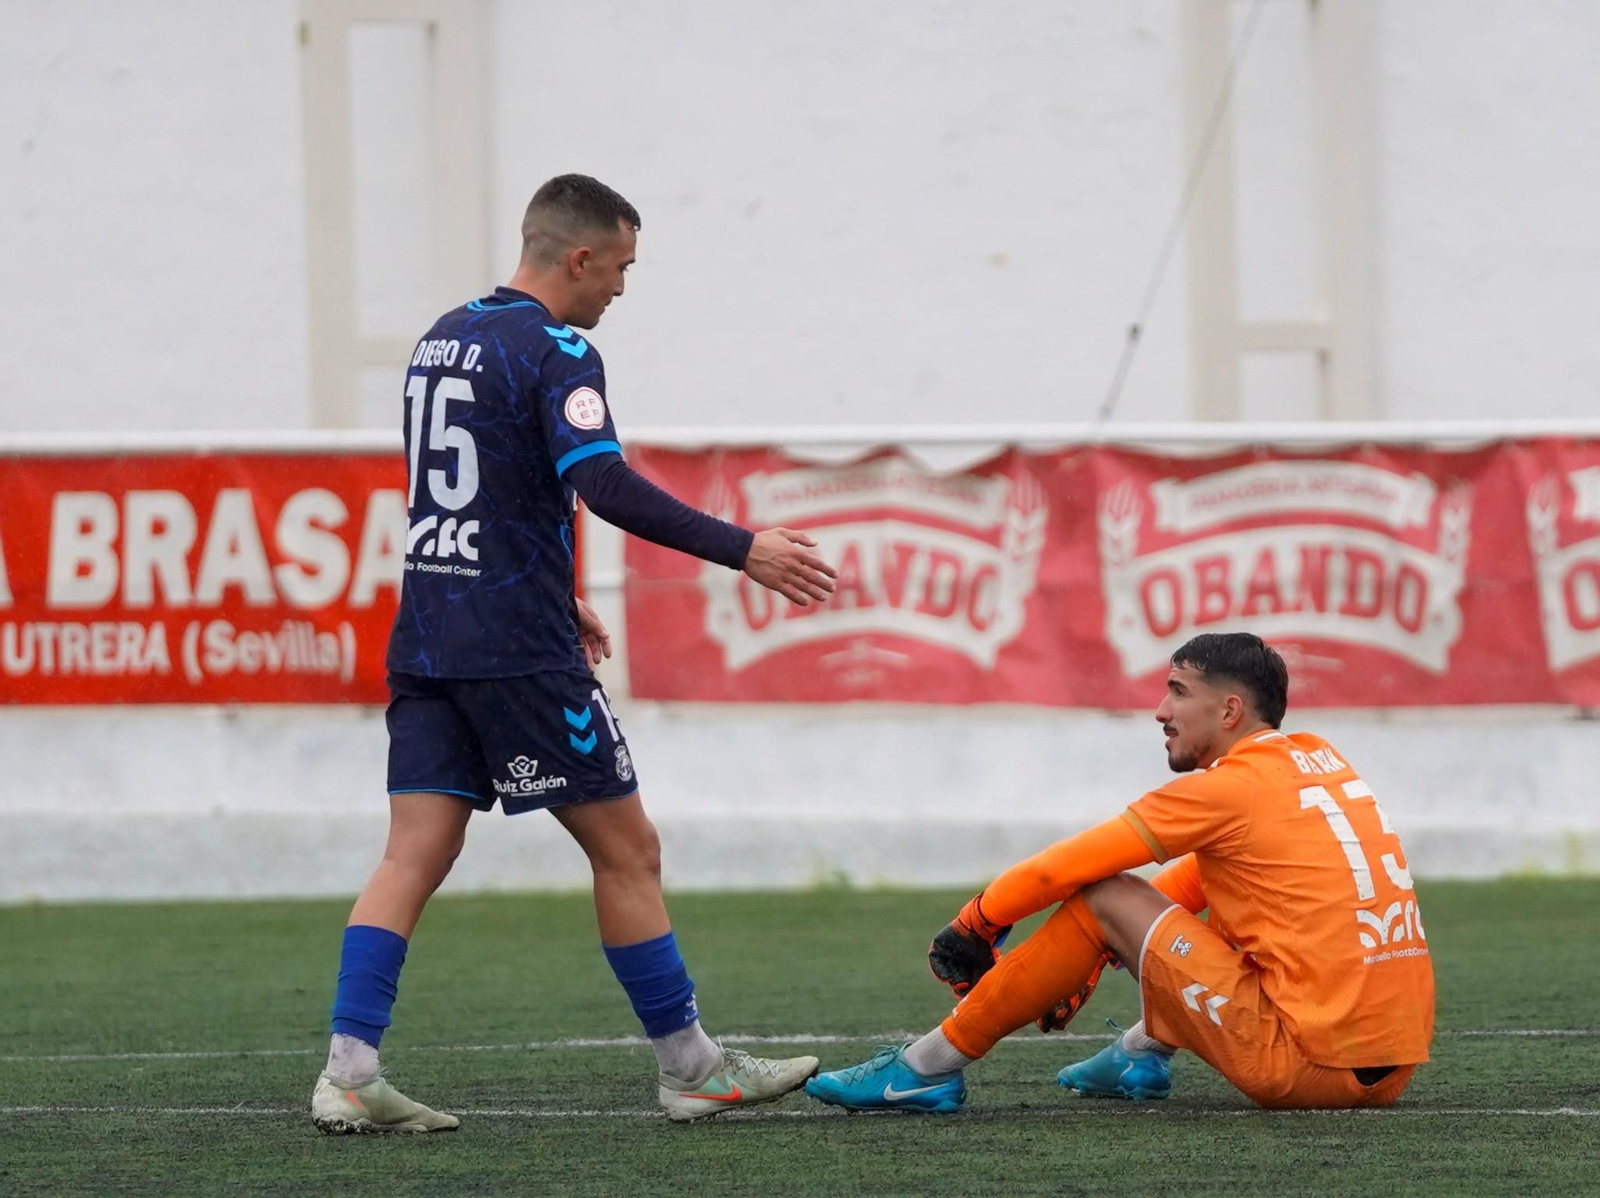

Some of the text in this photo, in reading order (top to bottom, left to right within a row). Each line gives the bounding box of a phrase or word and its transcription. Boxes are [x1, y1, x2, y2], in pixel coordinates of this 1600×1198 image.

[412, 339, 483, 372] DIEGO D.
[405, 375, 480, 511] 15
[47, 487, 407, 609] BRASA
[417, 562, 452, 574] Football
[1139, 543, 1428, 638] OBANDO
[3, 619, 357, 684] UTRERA (Sevilla)
[493, 775, 567, 793] Ruiz Galán
